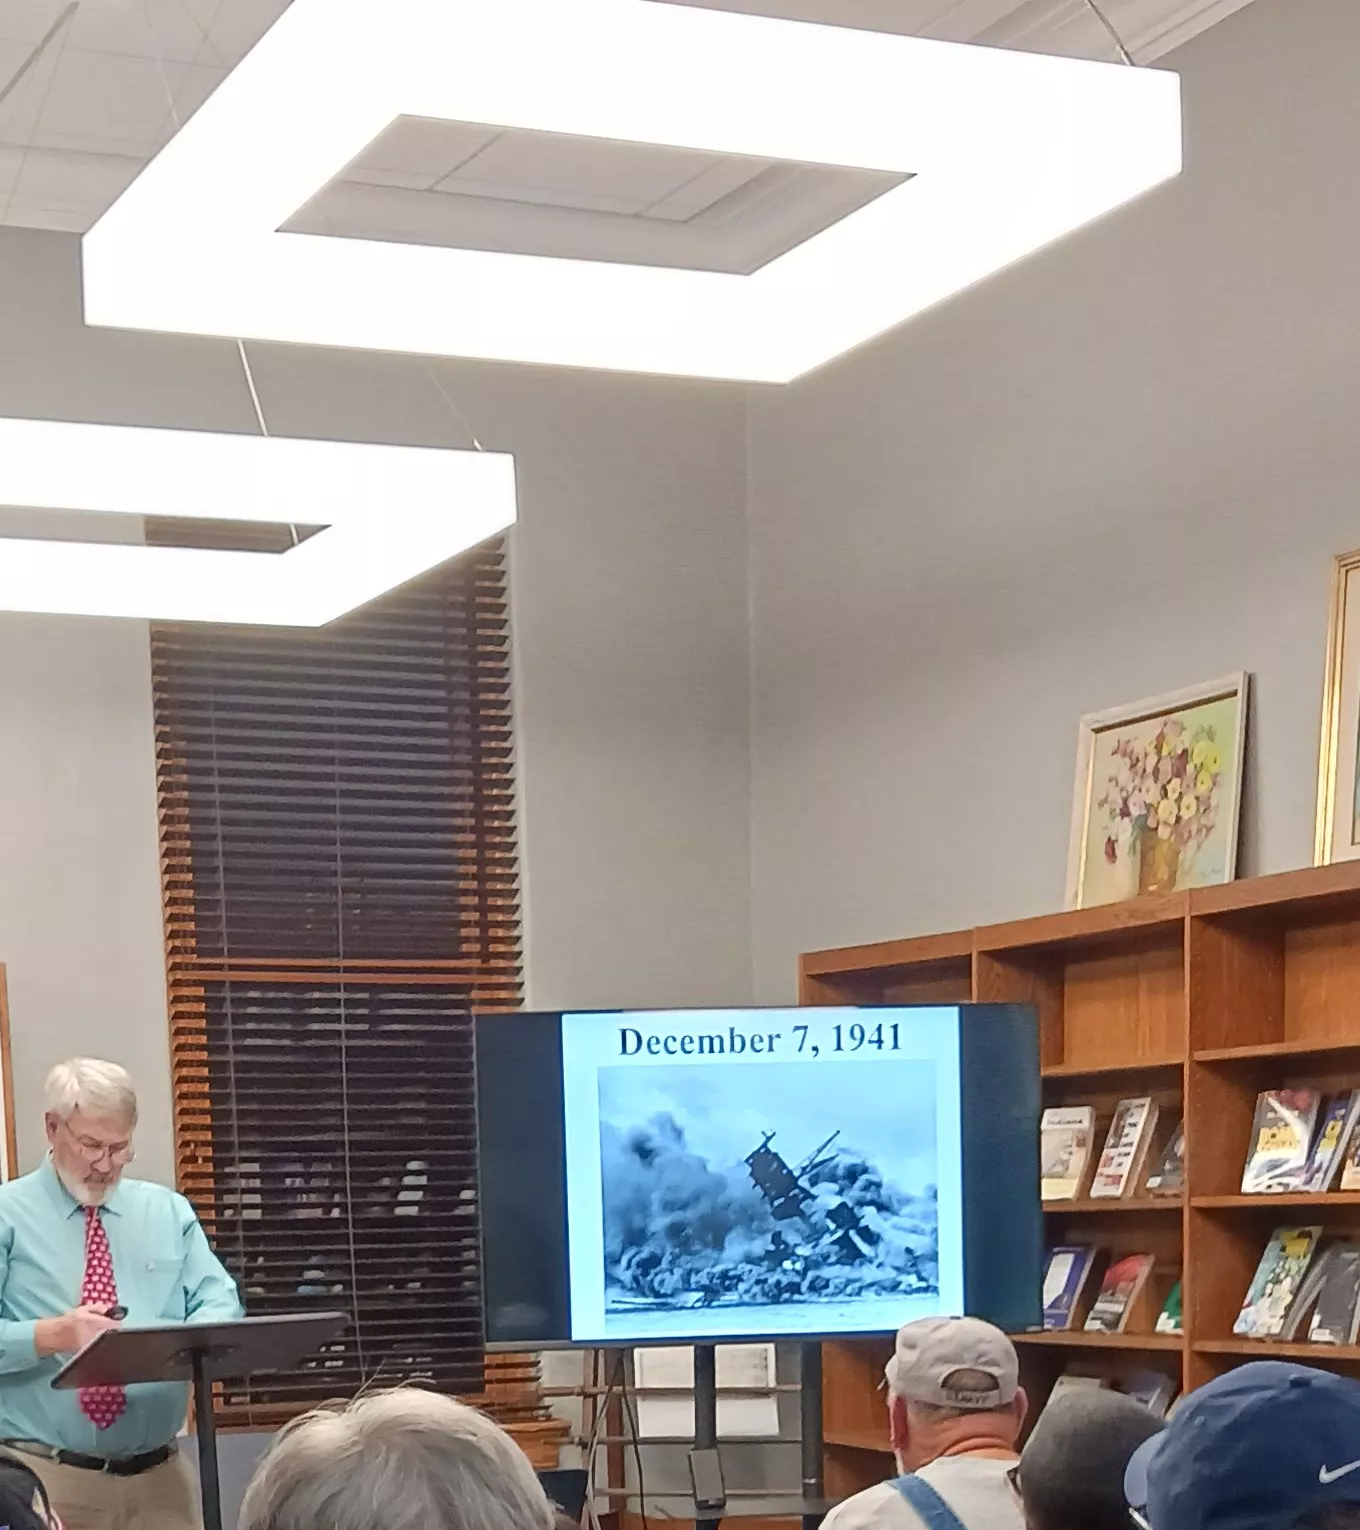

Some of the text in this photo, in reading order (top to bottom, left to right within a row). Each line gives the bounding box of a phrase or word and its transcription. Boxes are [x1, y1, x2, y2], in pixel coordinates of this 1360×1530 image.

[618, 1022, 903, 1058] December 7, 1941
